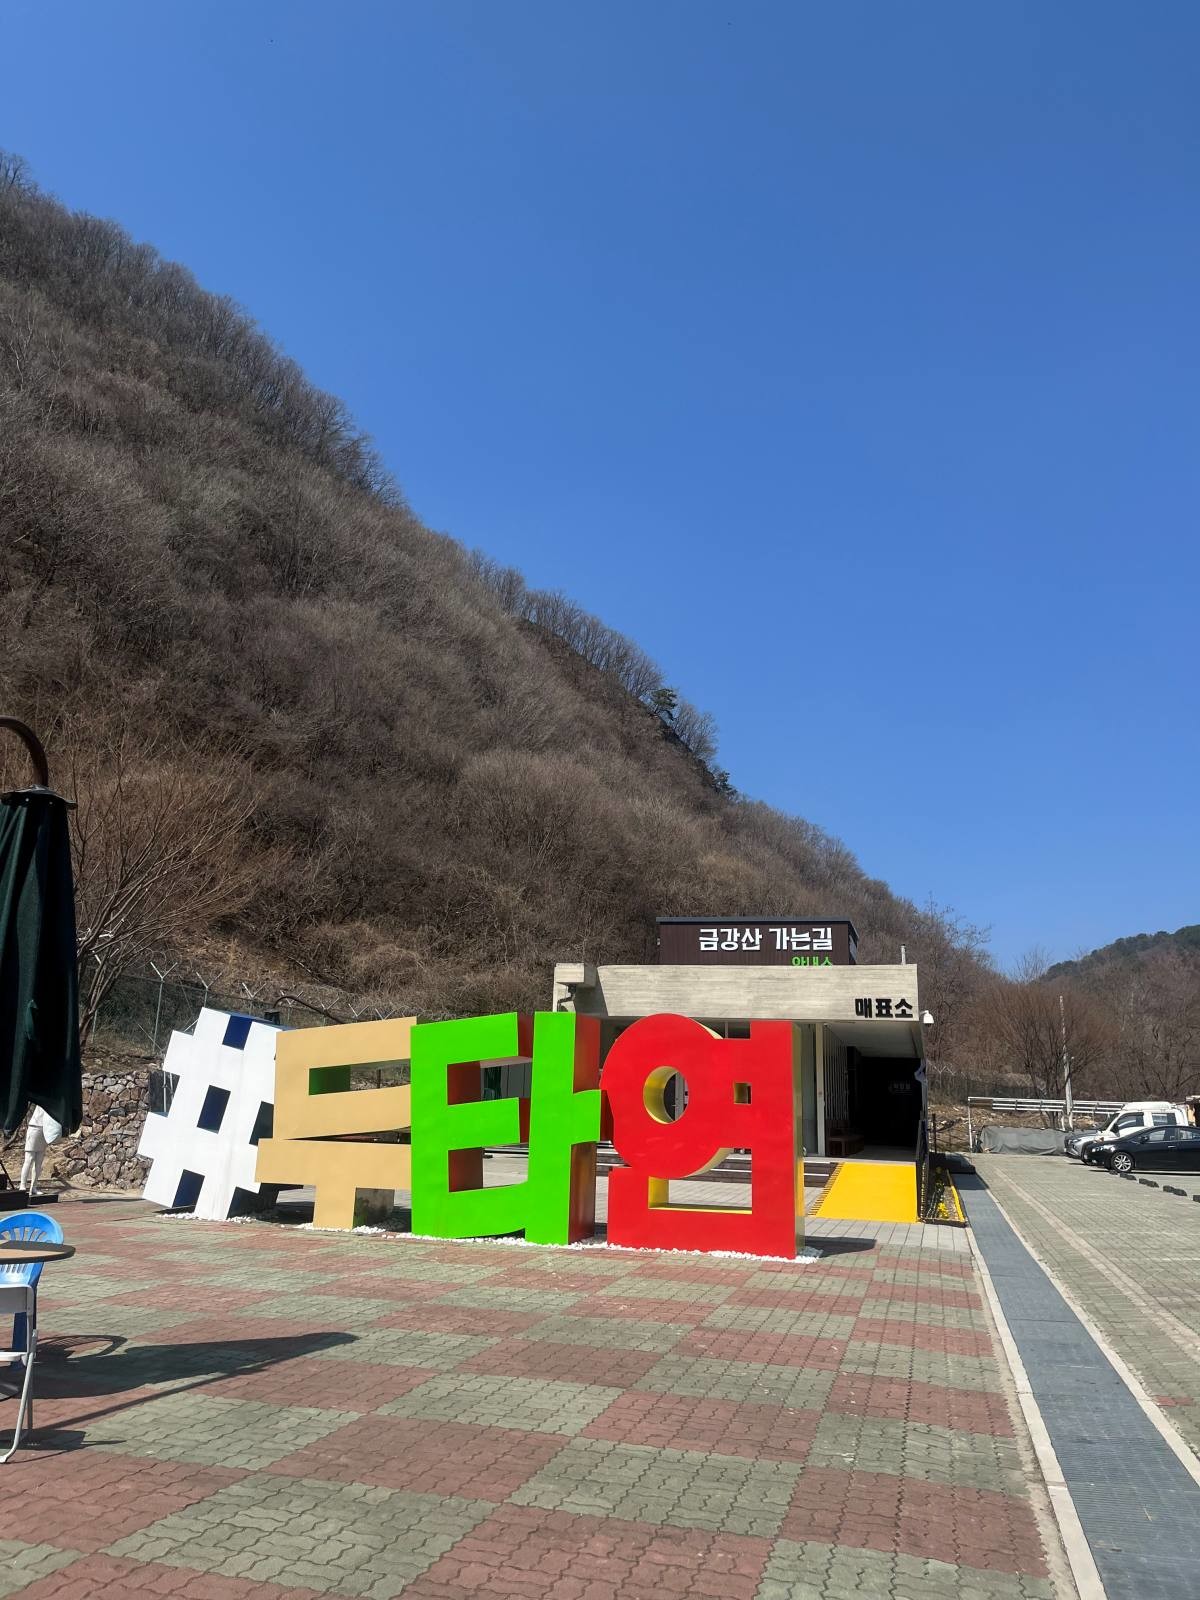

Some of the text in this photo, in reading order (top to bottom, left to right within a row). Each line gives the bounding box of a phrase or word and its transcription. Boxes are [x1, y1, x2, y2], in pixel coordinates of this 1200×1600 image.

[698, 927, 833, 951] 금강산 가는길
[855, 997, 914, 1018] 매표소
